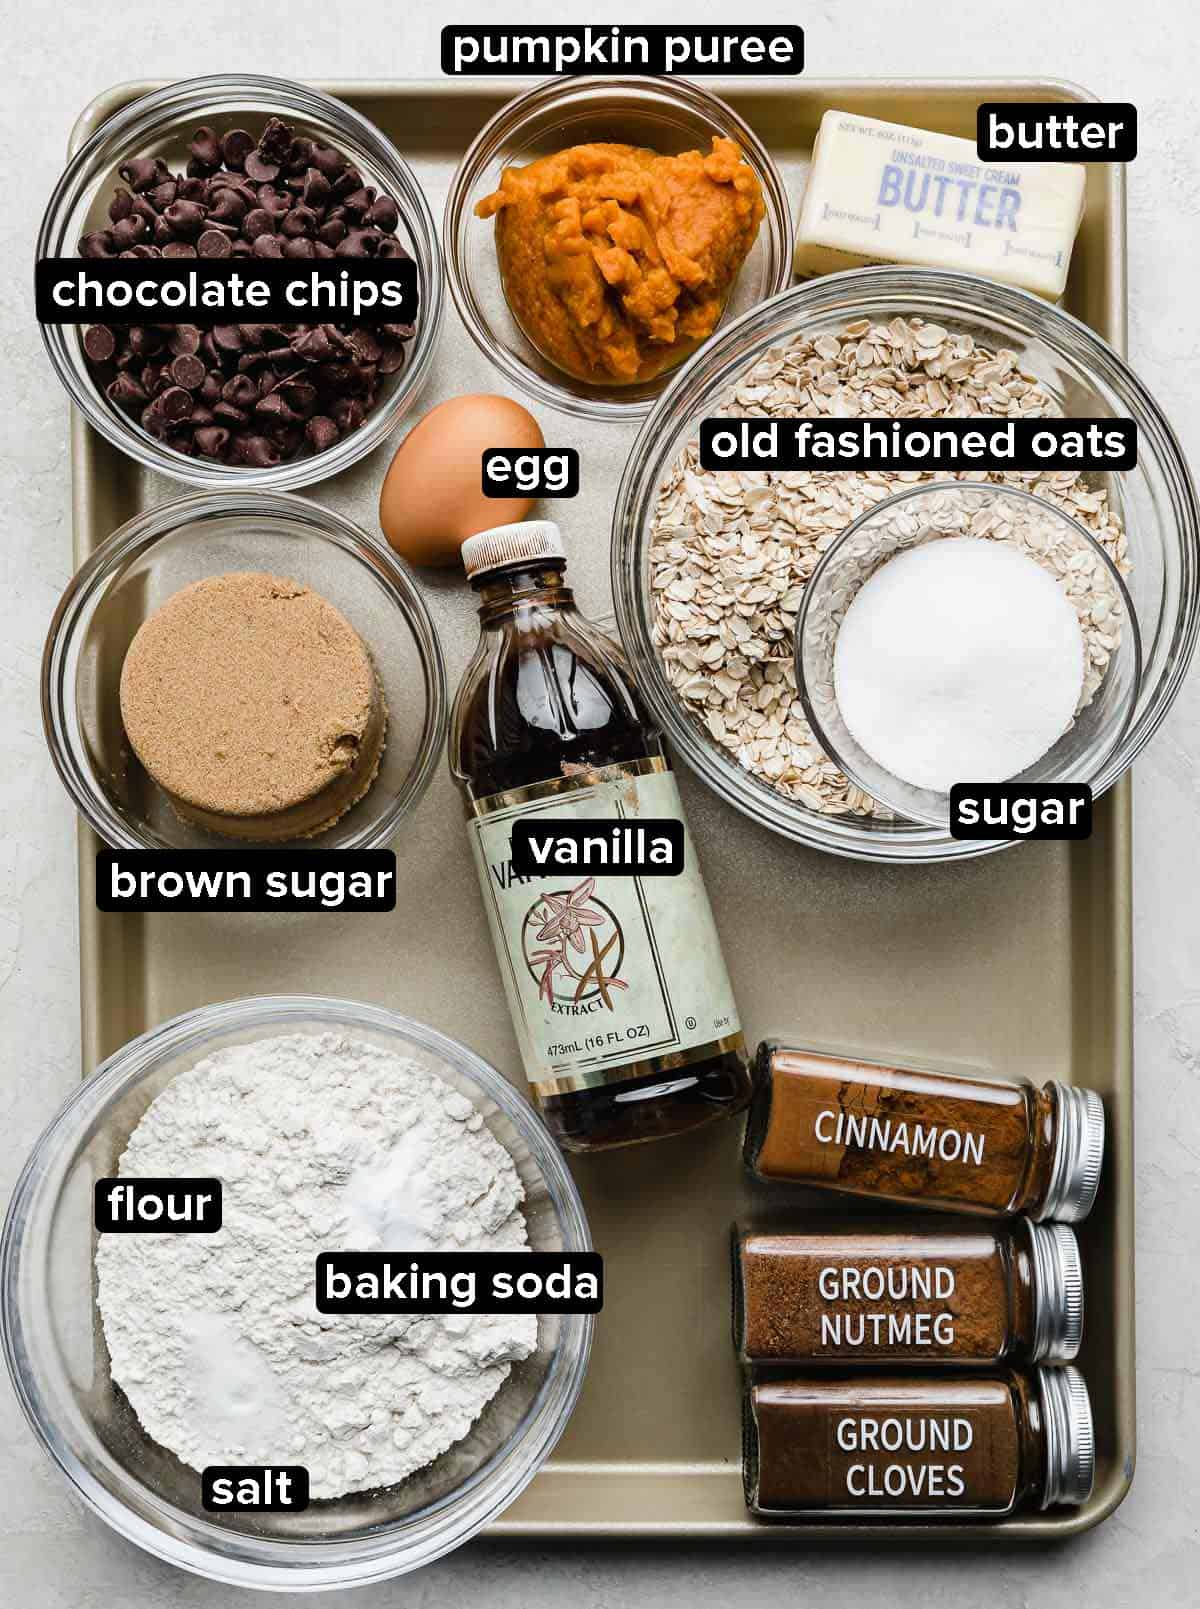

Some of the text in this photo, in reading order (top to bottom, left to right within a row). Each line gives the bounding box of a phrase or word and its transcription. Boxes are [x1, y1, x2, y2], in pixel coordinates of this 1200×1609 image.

[891, 149, 1021, 186] UNSALTED SWEET CREAM
[878, 164, 1022, 232] BUTTER
[551, 998, 604, 1016] EXTRACT
[547, 1024, 650, 1057] 473mL (16 FL OZ)
[814, 1110, 985, 1165] CINNAMON
[818, 1266, 955, 1300] GROUND
[821, 1313, 954, 1346] NUTMEG
[837, 1418, 973, 1451] GROUND
[846, 1464, 965, 1496] CLOVES
